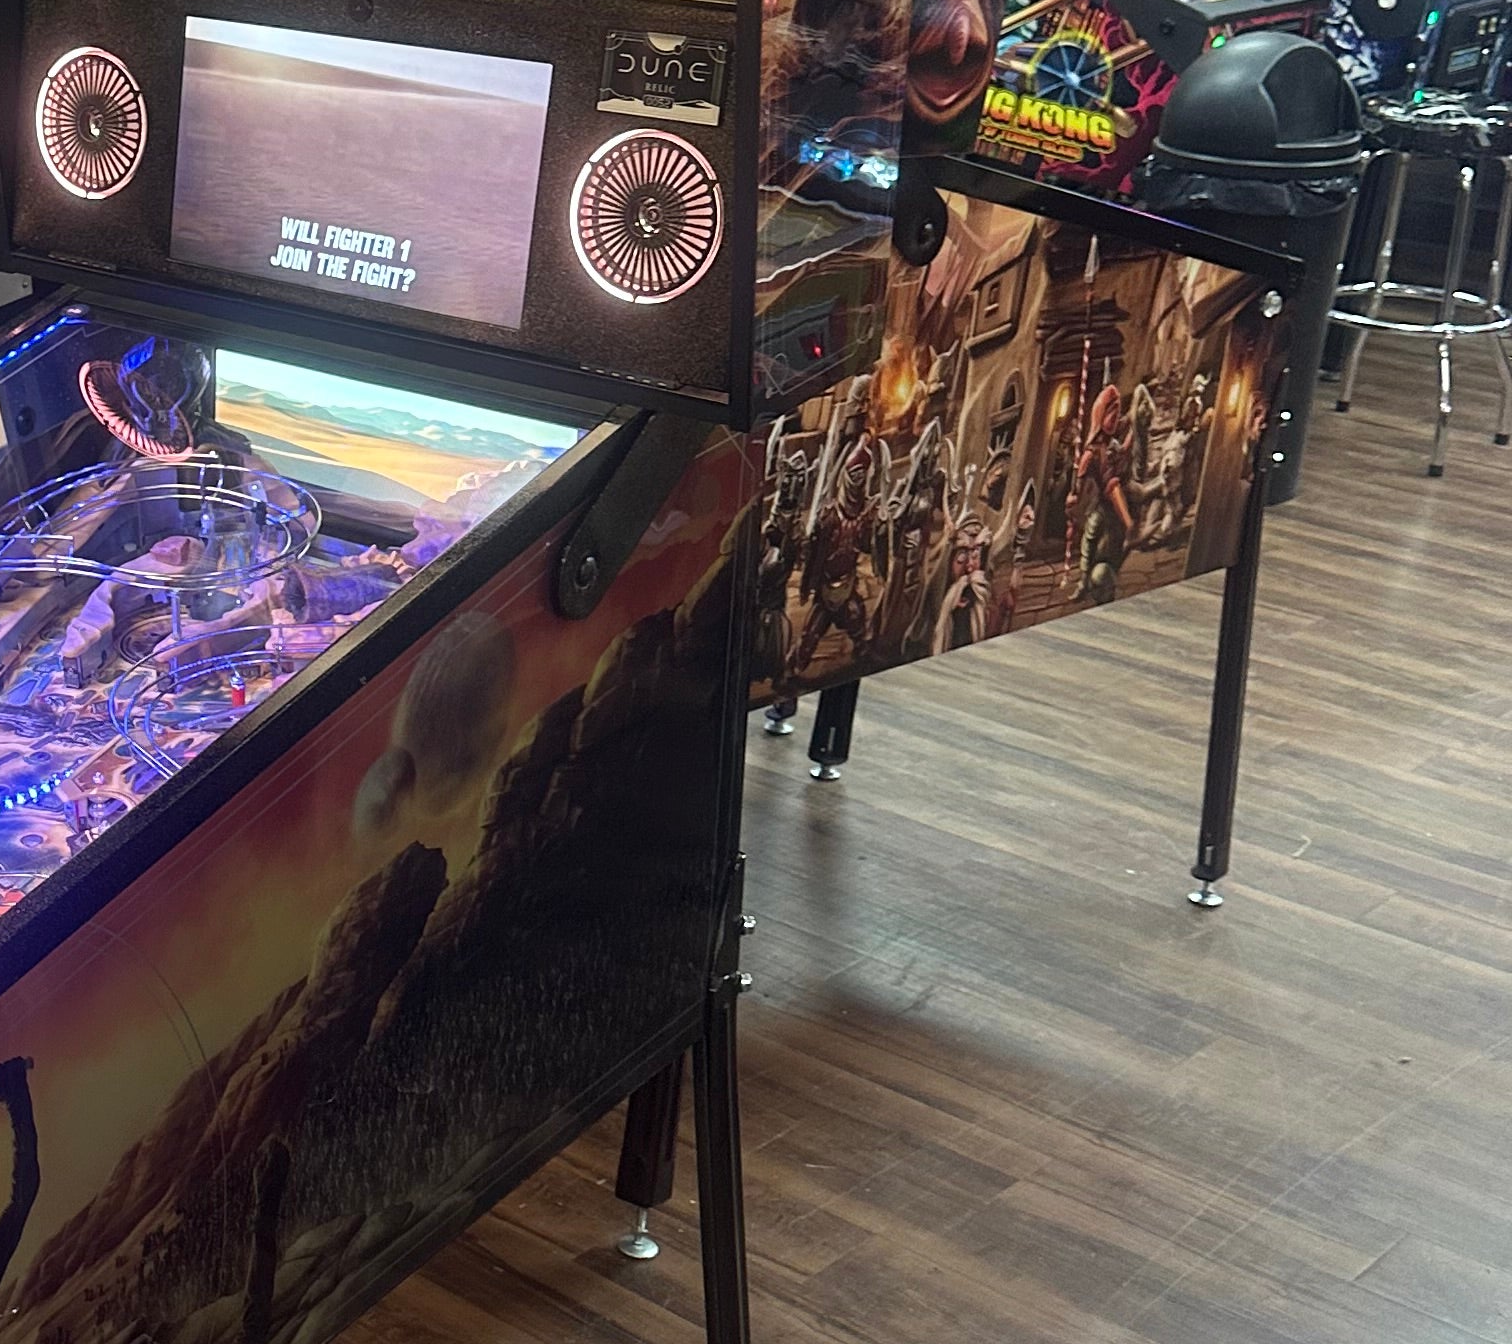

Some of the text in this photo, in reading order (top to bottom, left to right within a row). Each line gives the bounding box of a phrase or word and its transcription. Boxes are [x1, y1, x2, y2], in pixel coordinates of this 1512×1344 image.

[617, 53, 712, 82] DUNE
[644, 82, 676, 95] RELIC
[1018, 96, 1114, 150] KONG
[281, 216, 412, 262] WILL FIGHTER 1
[270, 244, 416, 292] JOIN THE FIGHT?
